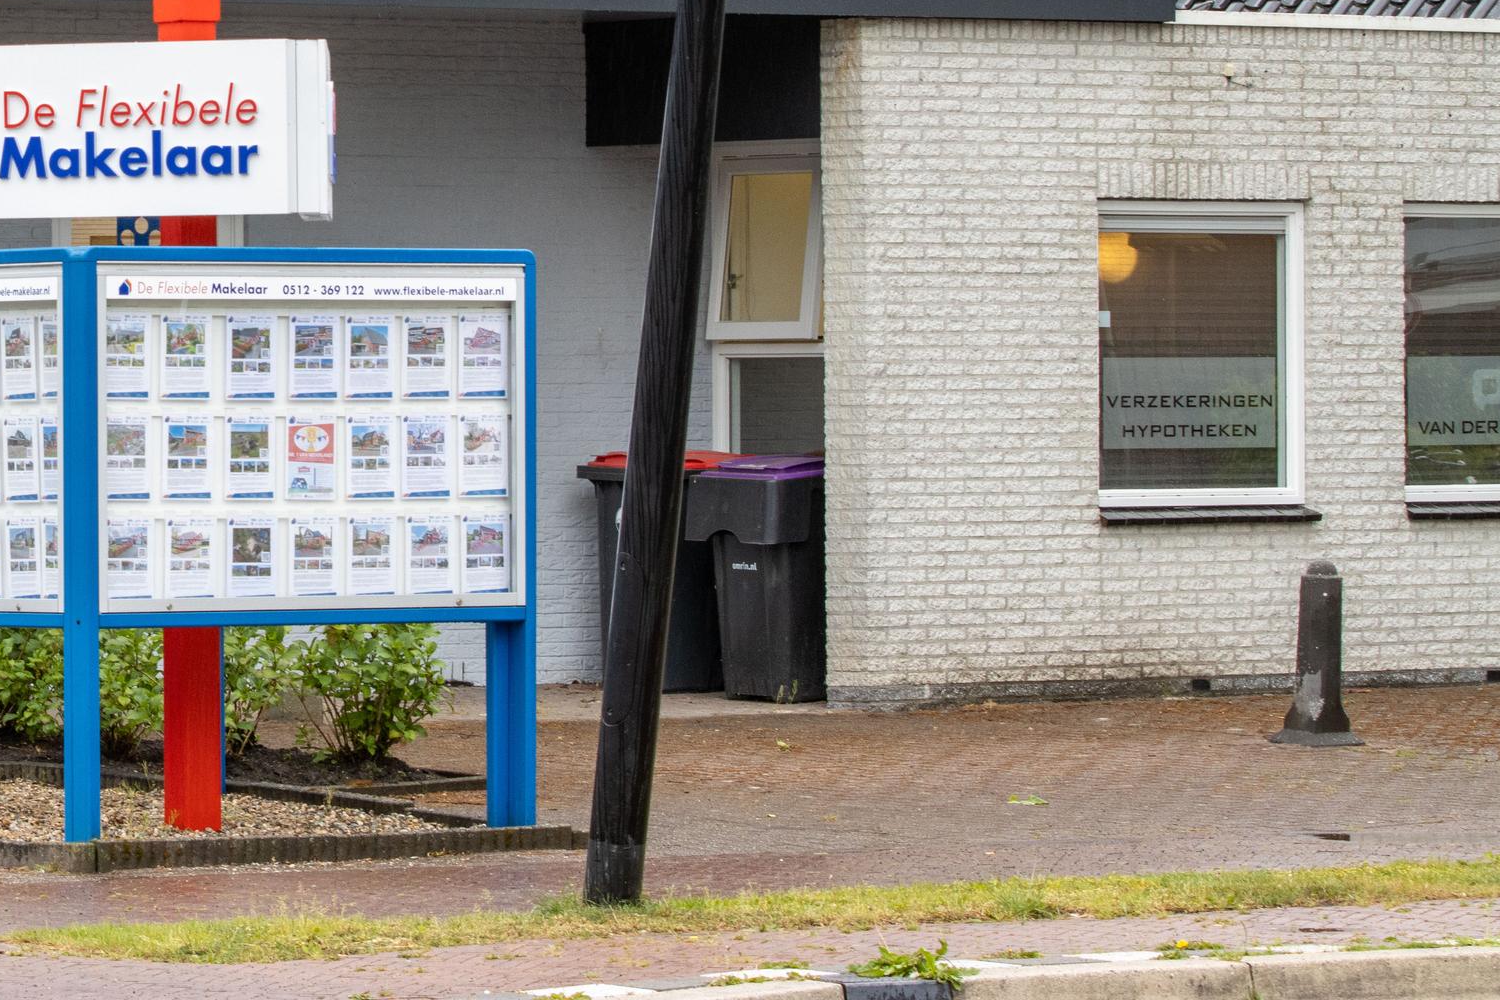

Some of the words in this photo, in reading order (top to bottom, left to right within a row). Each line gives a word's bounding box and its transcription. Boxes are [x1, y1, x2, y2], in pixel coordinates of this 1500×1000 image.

[3, 90, 56, 129] De
[76, 82, 258, 128] Flexibele
[137, 282, 153, 295] De
[157, 281, 208, 295] Flexibele
[211, 281, 268, 295] Makelaar
[282, 284, 310, 295] 0512
[320, 284, 340, 295] 369
[345, 284, 365, 295] 122
[374, 284, 505, 297] www.flexibele-makelaar.nl
[1106, 394, 1273, 408] VERZEKERINGEN
[1122, 424, 1257, 438] HYPOTHEKEN
[1418, 421, 1455, 435] VAN
[1462, 420, 1499, 434] DER
